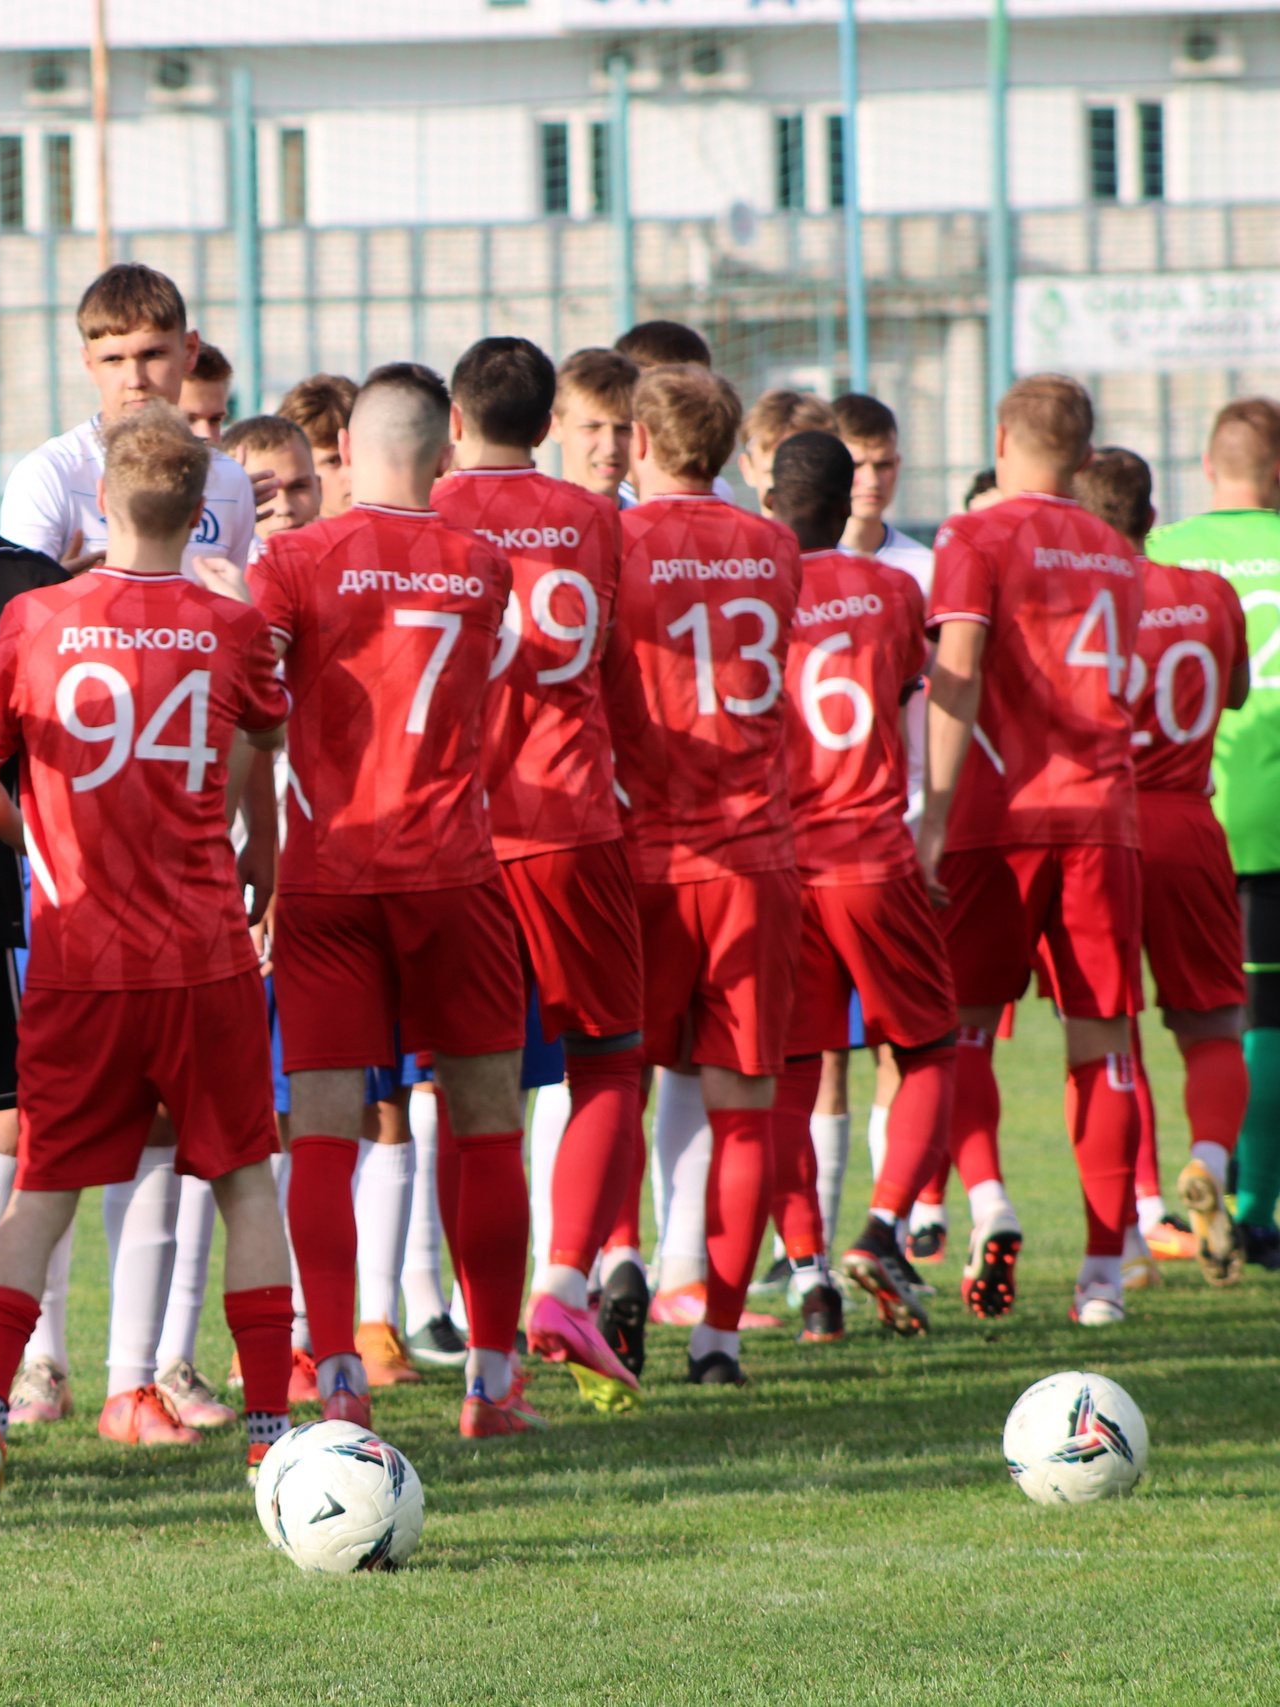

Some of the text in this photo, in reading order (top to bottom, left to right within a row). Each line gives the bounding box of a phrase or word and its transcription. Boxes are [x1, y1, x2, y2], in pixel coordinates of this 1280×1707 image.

[472, 526, 580, 548] ЬКОВО
[649, 557, 776, 585] ДЯТЬКОВО
[1033, 547, 1135, 577] ДЯТЬКОВО
[337, 569, 484, 598] ДЯТЬКОВО
[791, 593, 883, 627] ЬКОВО
[1138, 603, 1209, 629] КОВО
[57, 626, 217, 655] ДЯТЬКОВО
[666, 597, 782, 716] 13
[1065, 587, 1126, 696] 4
[393, 609, 462, 734] 7
[800, 631, 874, 751] 6
[55, 661, 218, 793] 94
